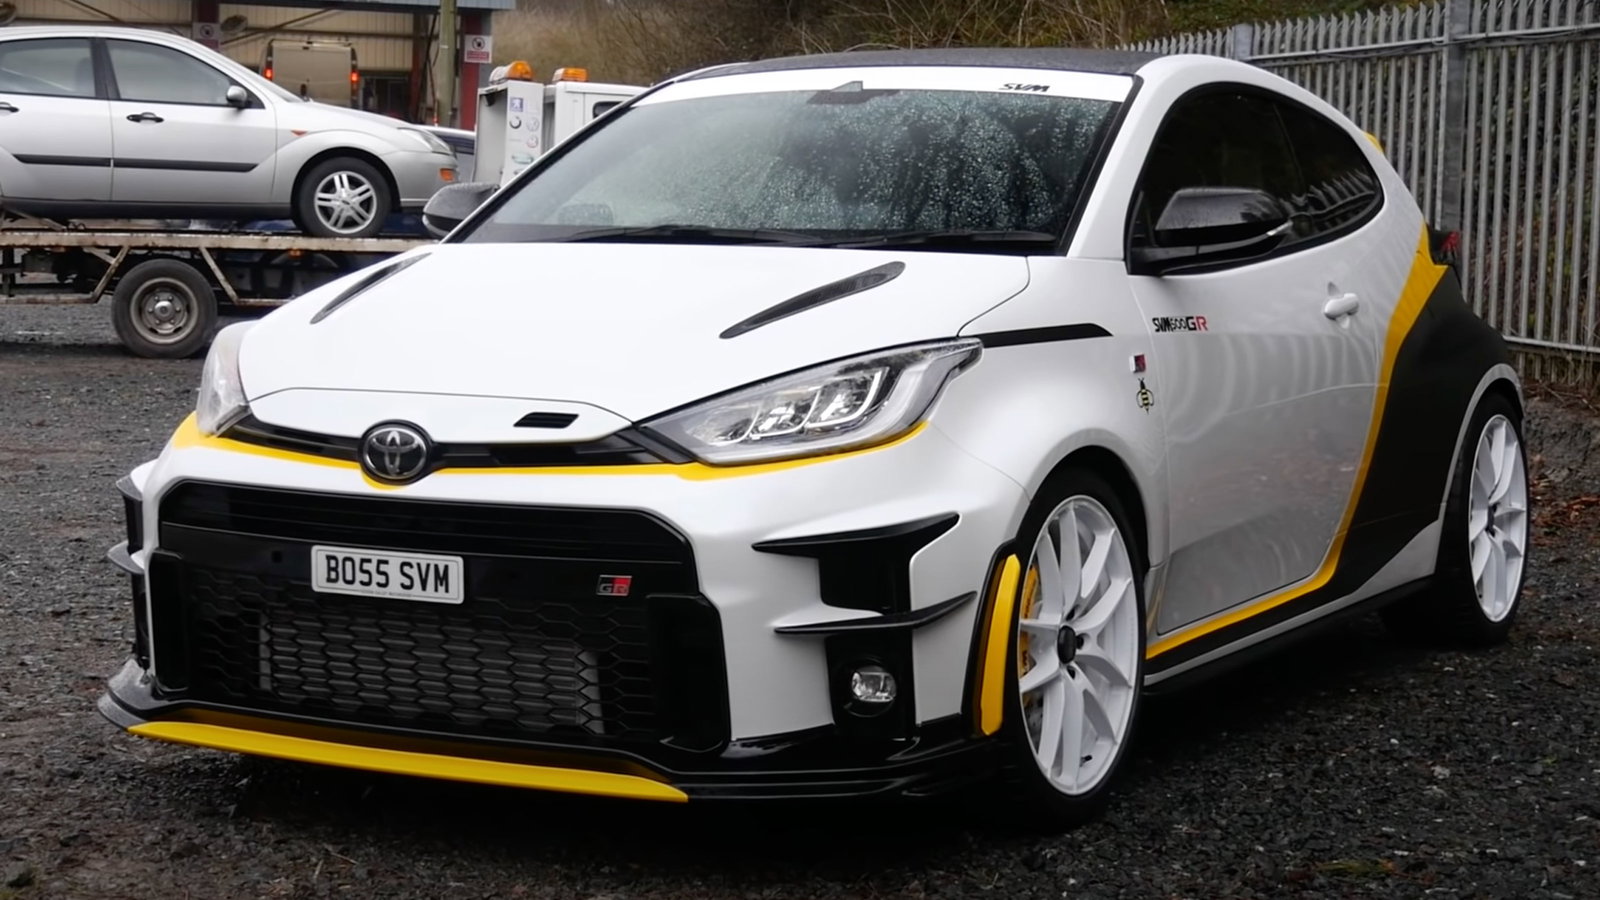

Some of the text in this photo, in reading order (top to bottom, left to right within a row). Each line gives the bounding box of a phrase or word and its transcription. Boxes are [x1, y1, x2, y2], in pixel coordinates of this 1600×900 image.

[999, 83, 1050, 93] SVM
[326, 555, 449, 593] BO55 SVM
